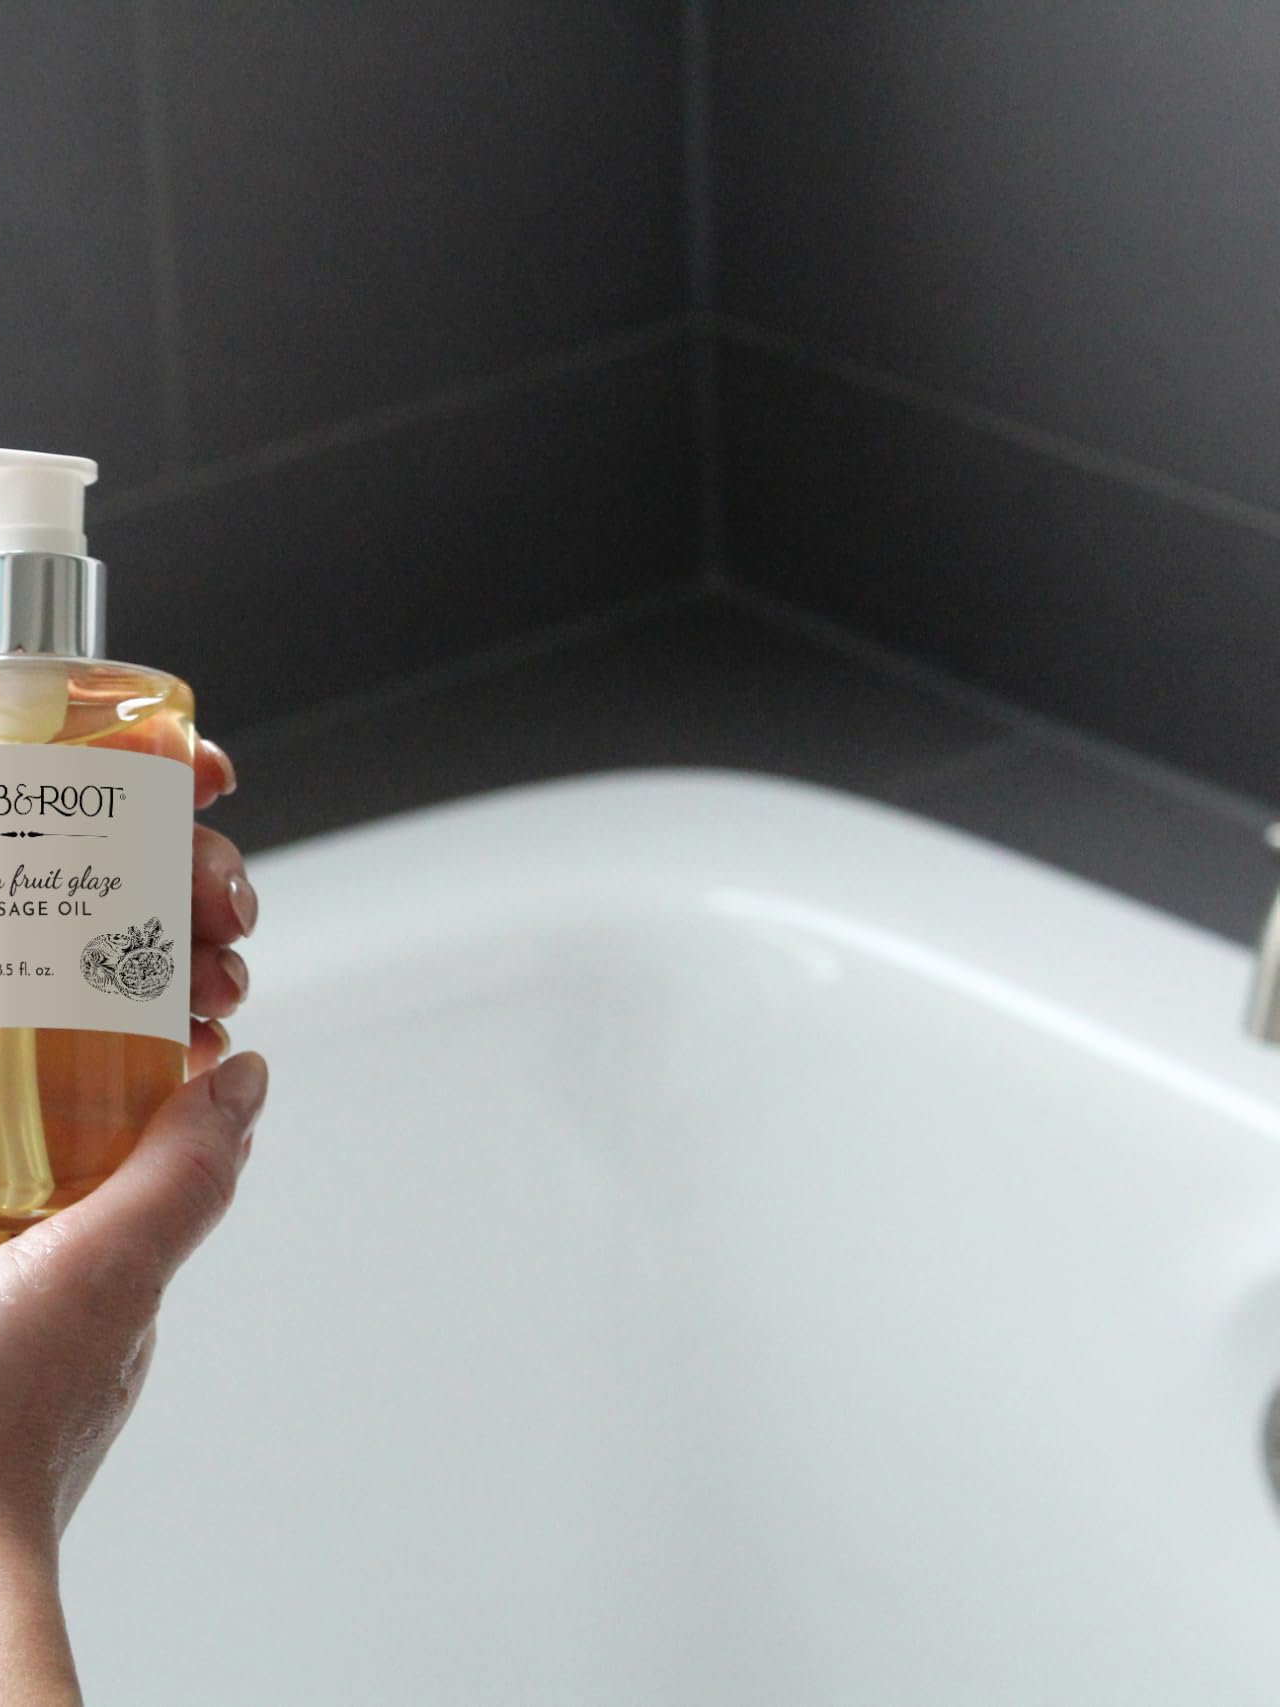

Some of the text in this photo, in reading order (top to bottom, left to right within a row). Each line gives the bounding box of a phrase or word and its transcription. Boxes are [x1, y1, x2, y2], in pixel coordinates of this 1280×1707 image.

[9, 864, 63, 897] fruit
[67, 865, 123, 898] glaze
[58, 901, 92, 916] OIL
[19, 961, 31, 976] fl.
[35, 967, 54, 976] oz.
